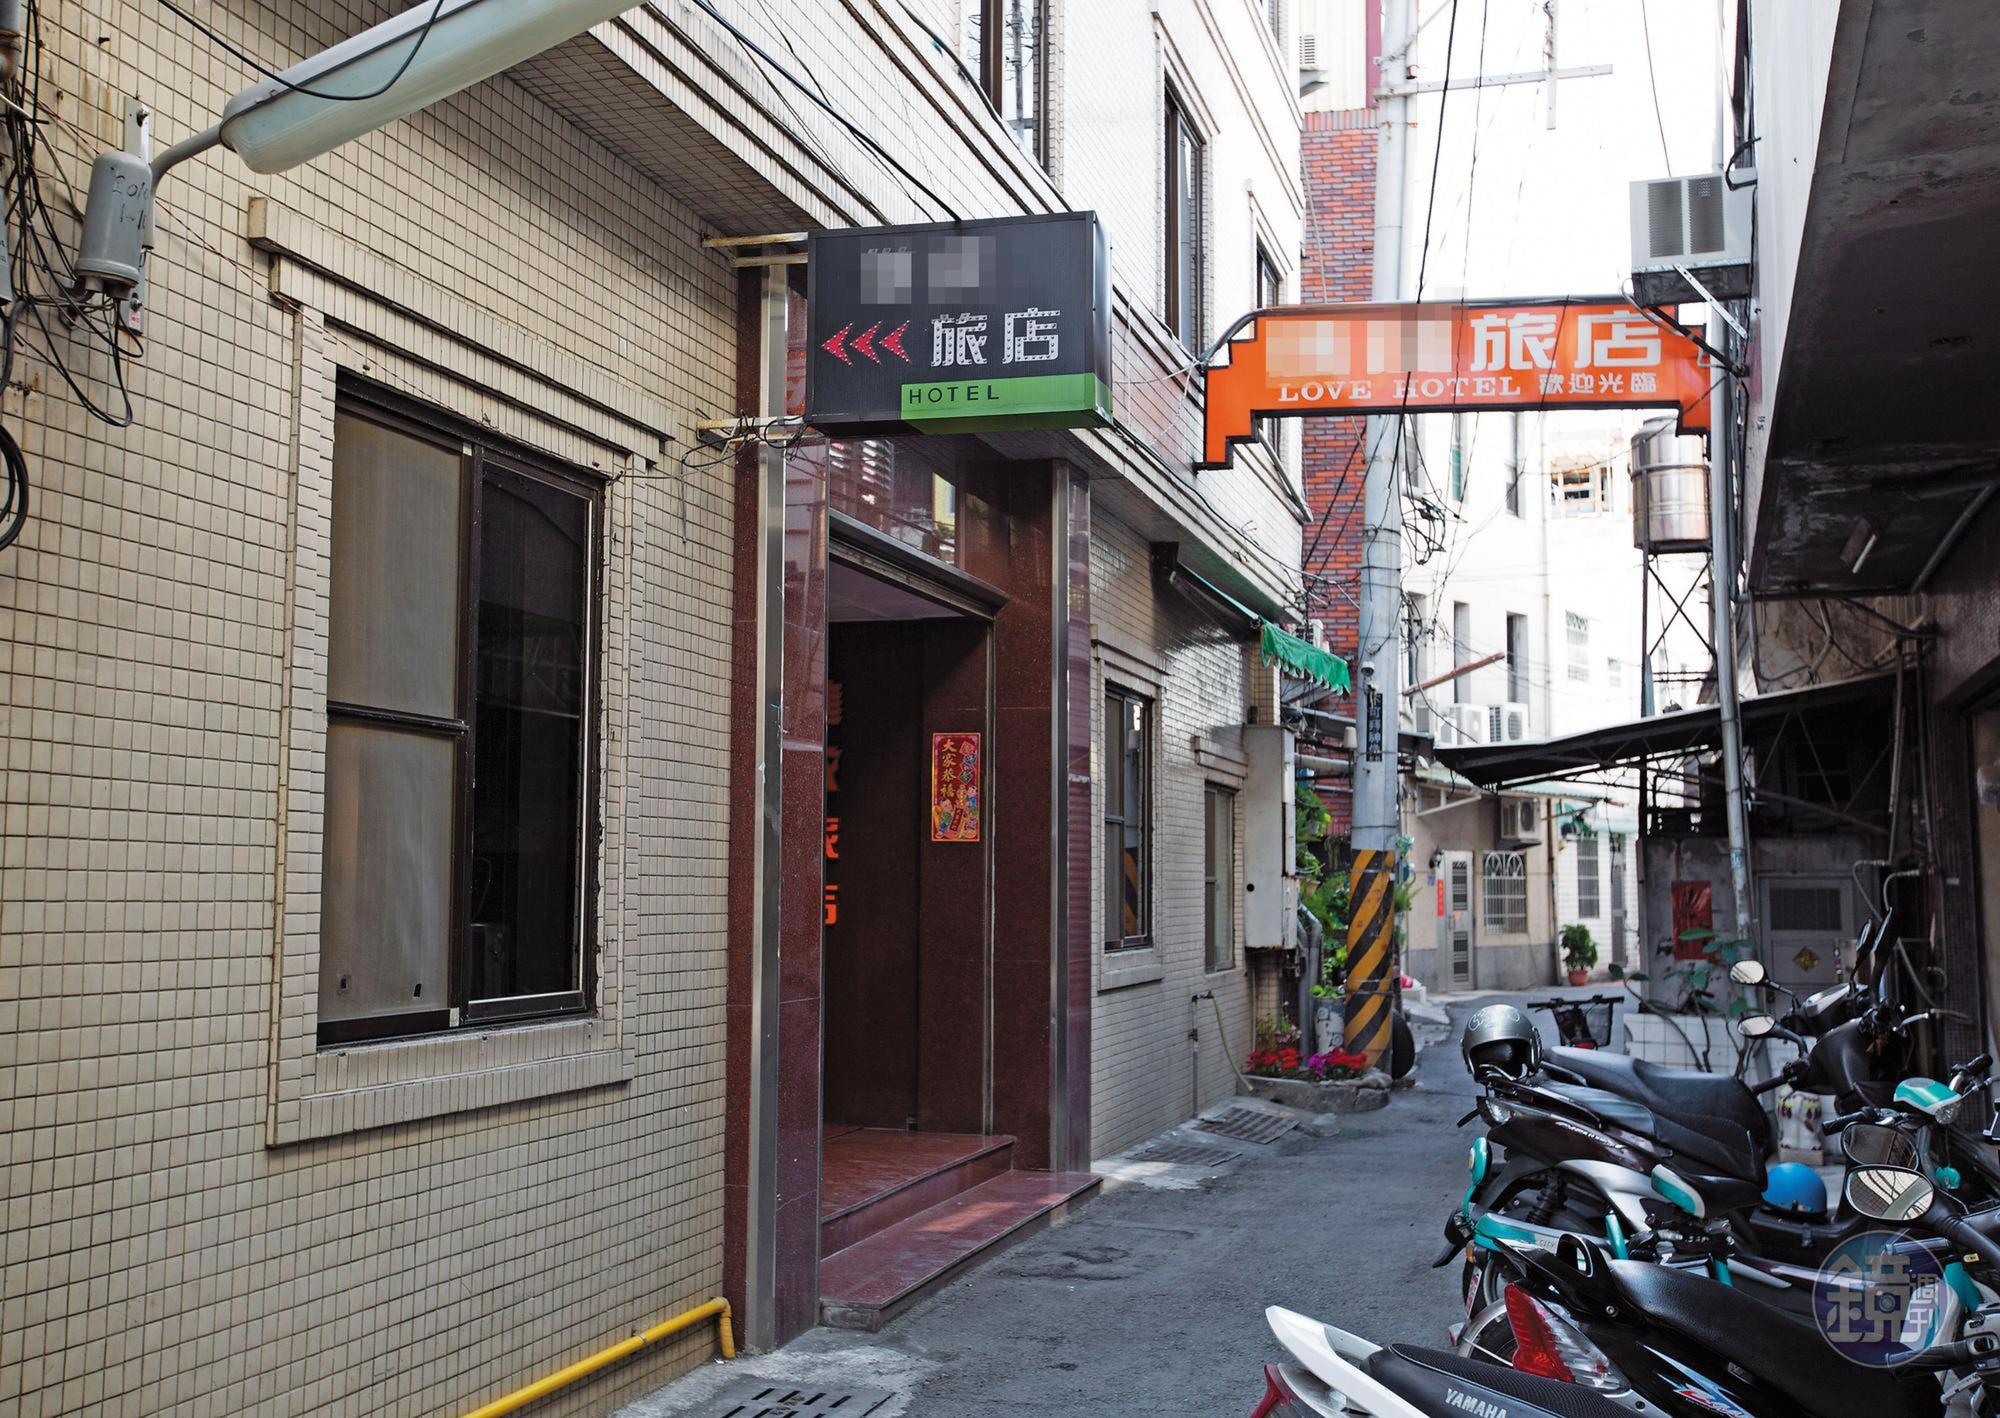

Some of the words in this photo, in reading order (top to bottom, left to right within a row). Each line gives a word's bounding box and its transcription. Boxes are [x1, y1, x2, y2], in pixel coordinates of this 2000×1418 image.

[930, 307, 1061, 368] 旅店
[1470, 310, 1662, 372] 旅店
[908, 384, 1000, 405] HOTEL
[1278, 380, 1372, 402] LOVE
[1393, 376, 1521, 399] HOTEL
[1539, 371, 1658, 396] 歡迎光臨
[1444, 1387, 1508, 1418] YAMAHA
